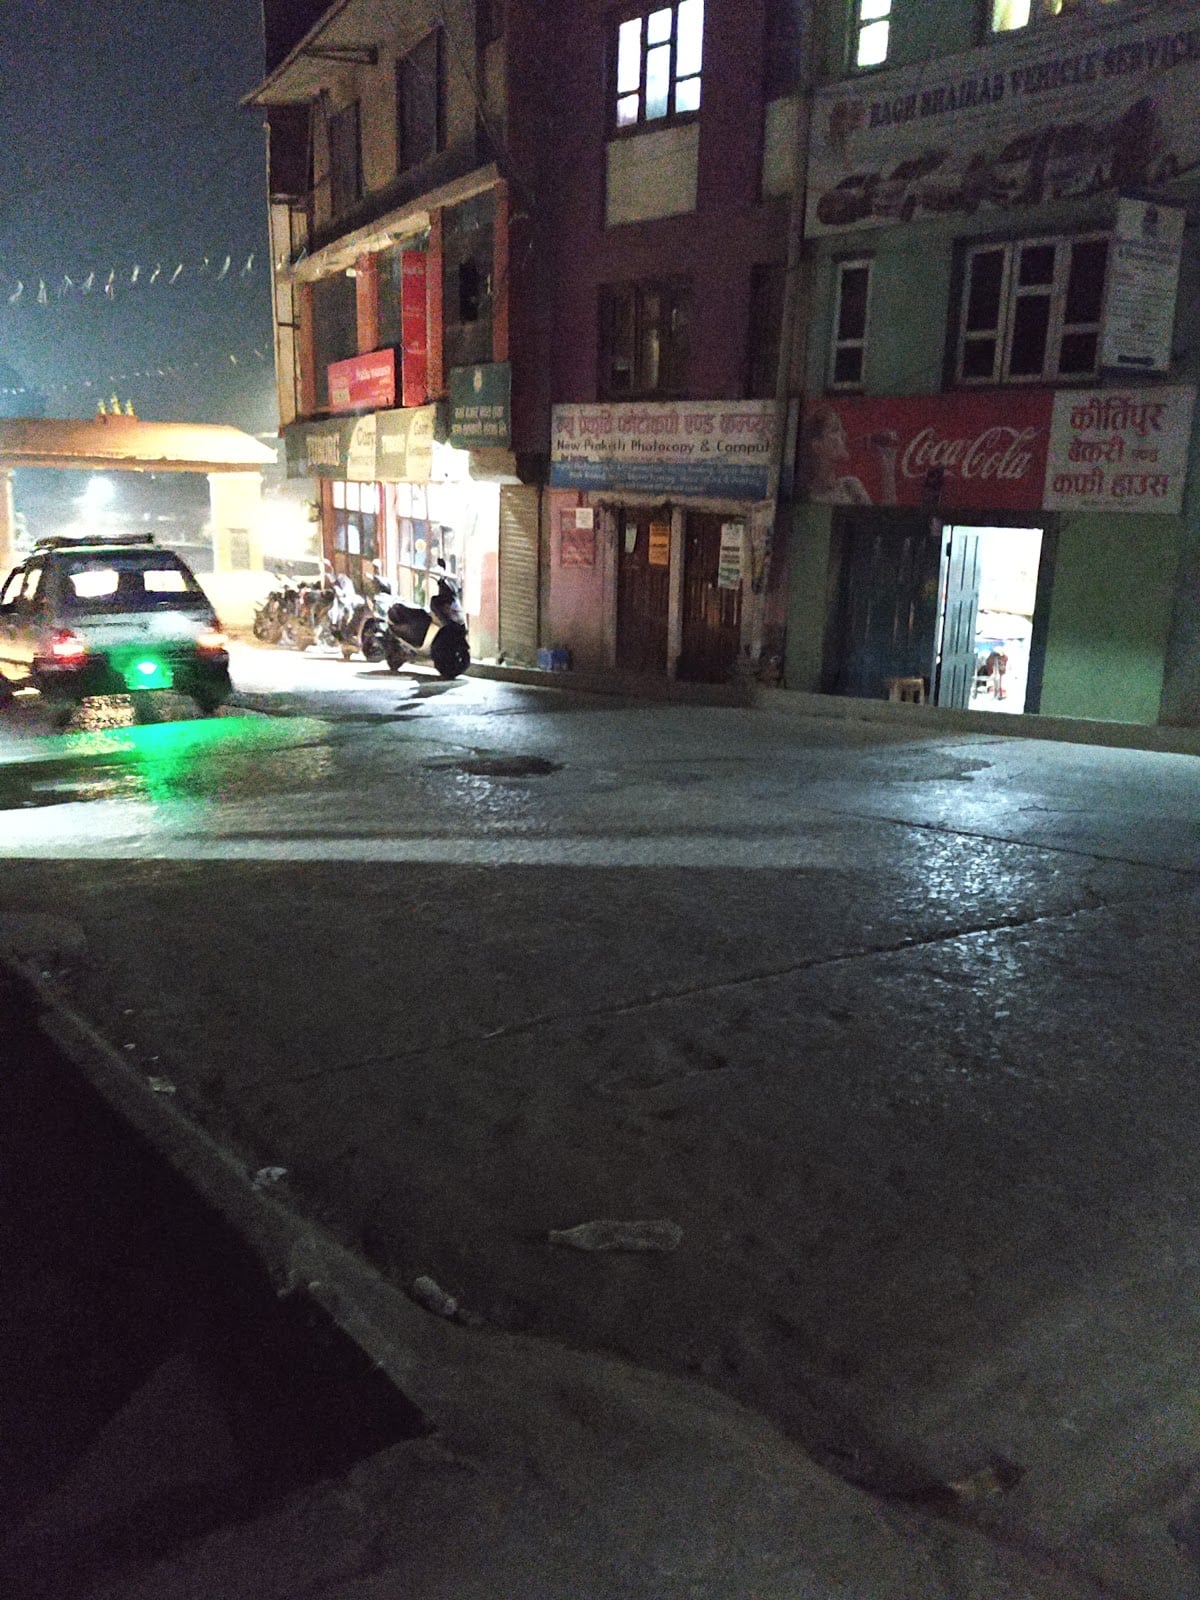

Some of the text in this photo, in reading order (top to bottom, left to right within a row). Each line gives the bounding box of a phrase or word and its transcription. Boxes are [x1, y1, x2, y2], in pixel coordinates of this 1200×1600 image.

[556, 439, 580, 450] New
[631, 439, 695, 454] Photocopy
[700, 440, 711, 452] &
